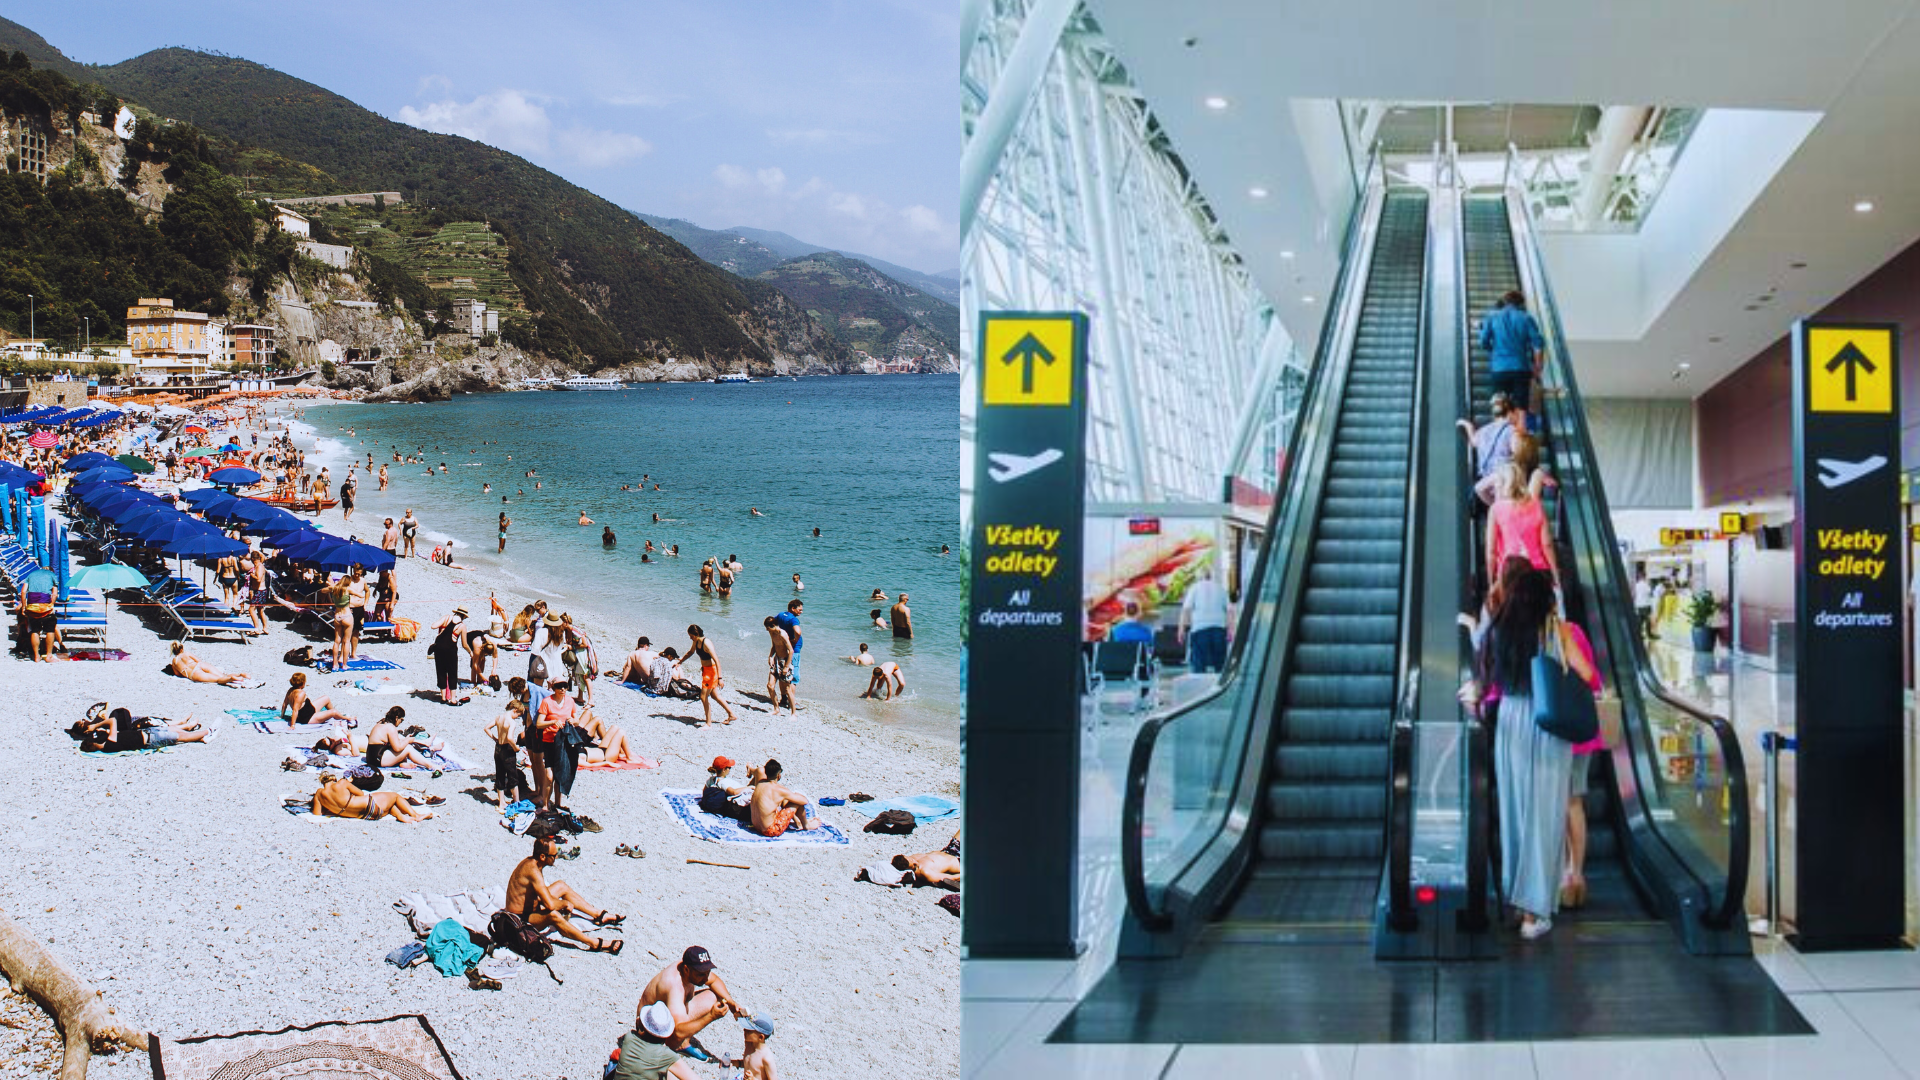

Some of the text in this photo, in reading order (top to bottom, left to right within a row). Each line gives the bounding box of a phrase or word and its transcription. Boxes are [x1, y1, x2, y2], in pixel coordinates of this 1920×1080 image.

[986, 525, 1060, 550] Všetky
[1818, 529, 1887, 554] Všetky
[986, 551, 1057, 577] odlety
[1819, 555, 1885, 580] odlety
[1007, 590, 1031, 606] All
[1841, 592, 1863, 608] All
[979, 608, 1062, 628] departures
[1814, 611, 1892, 630] departures
